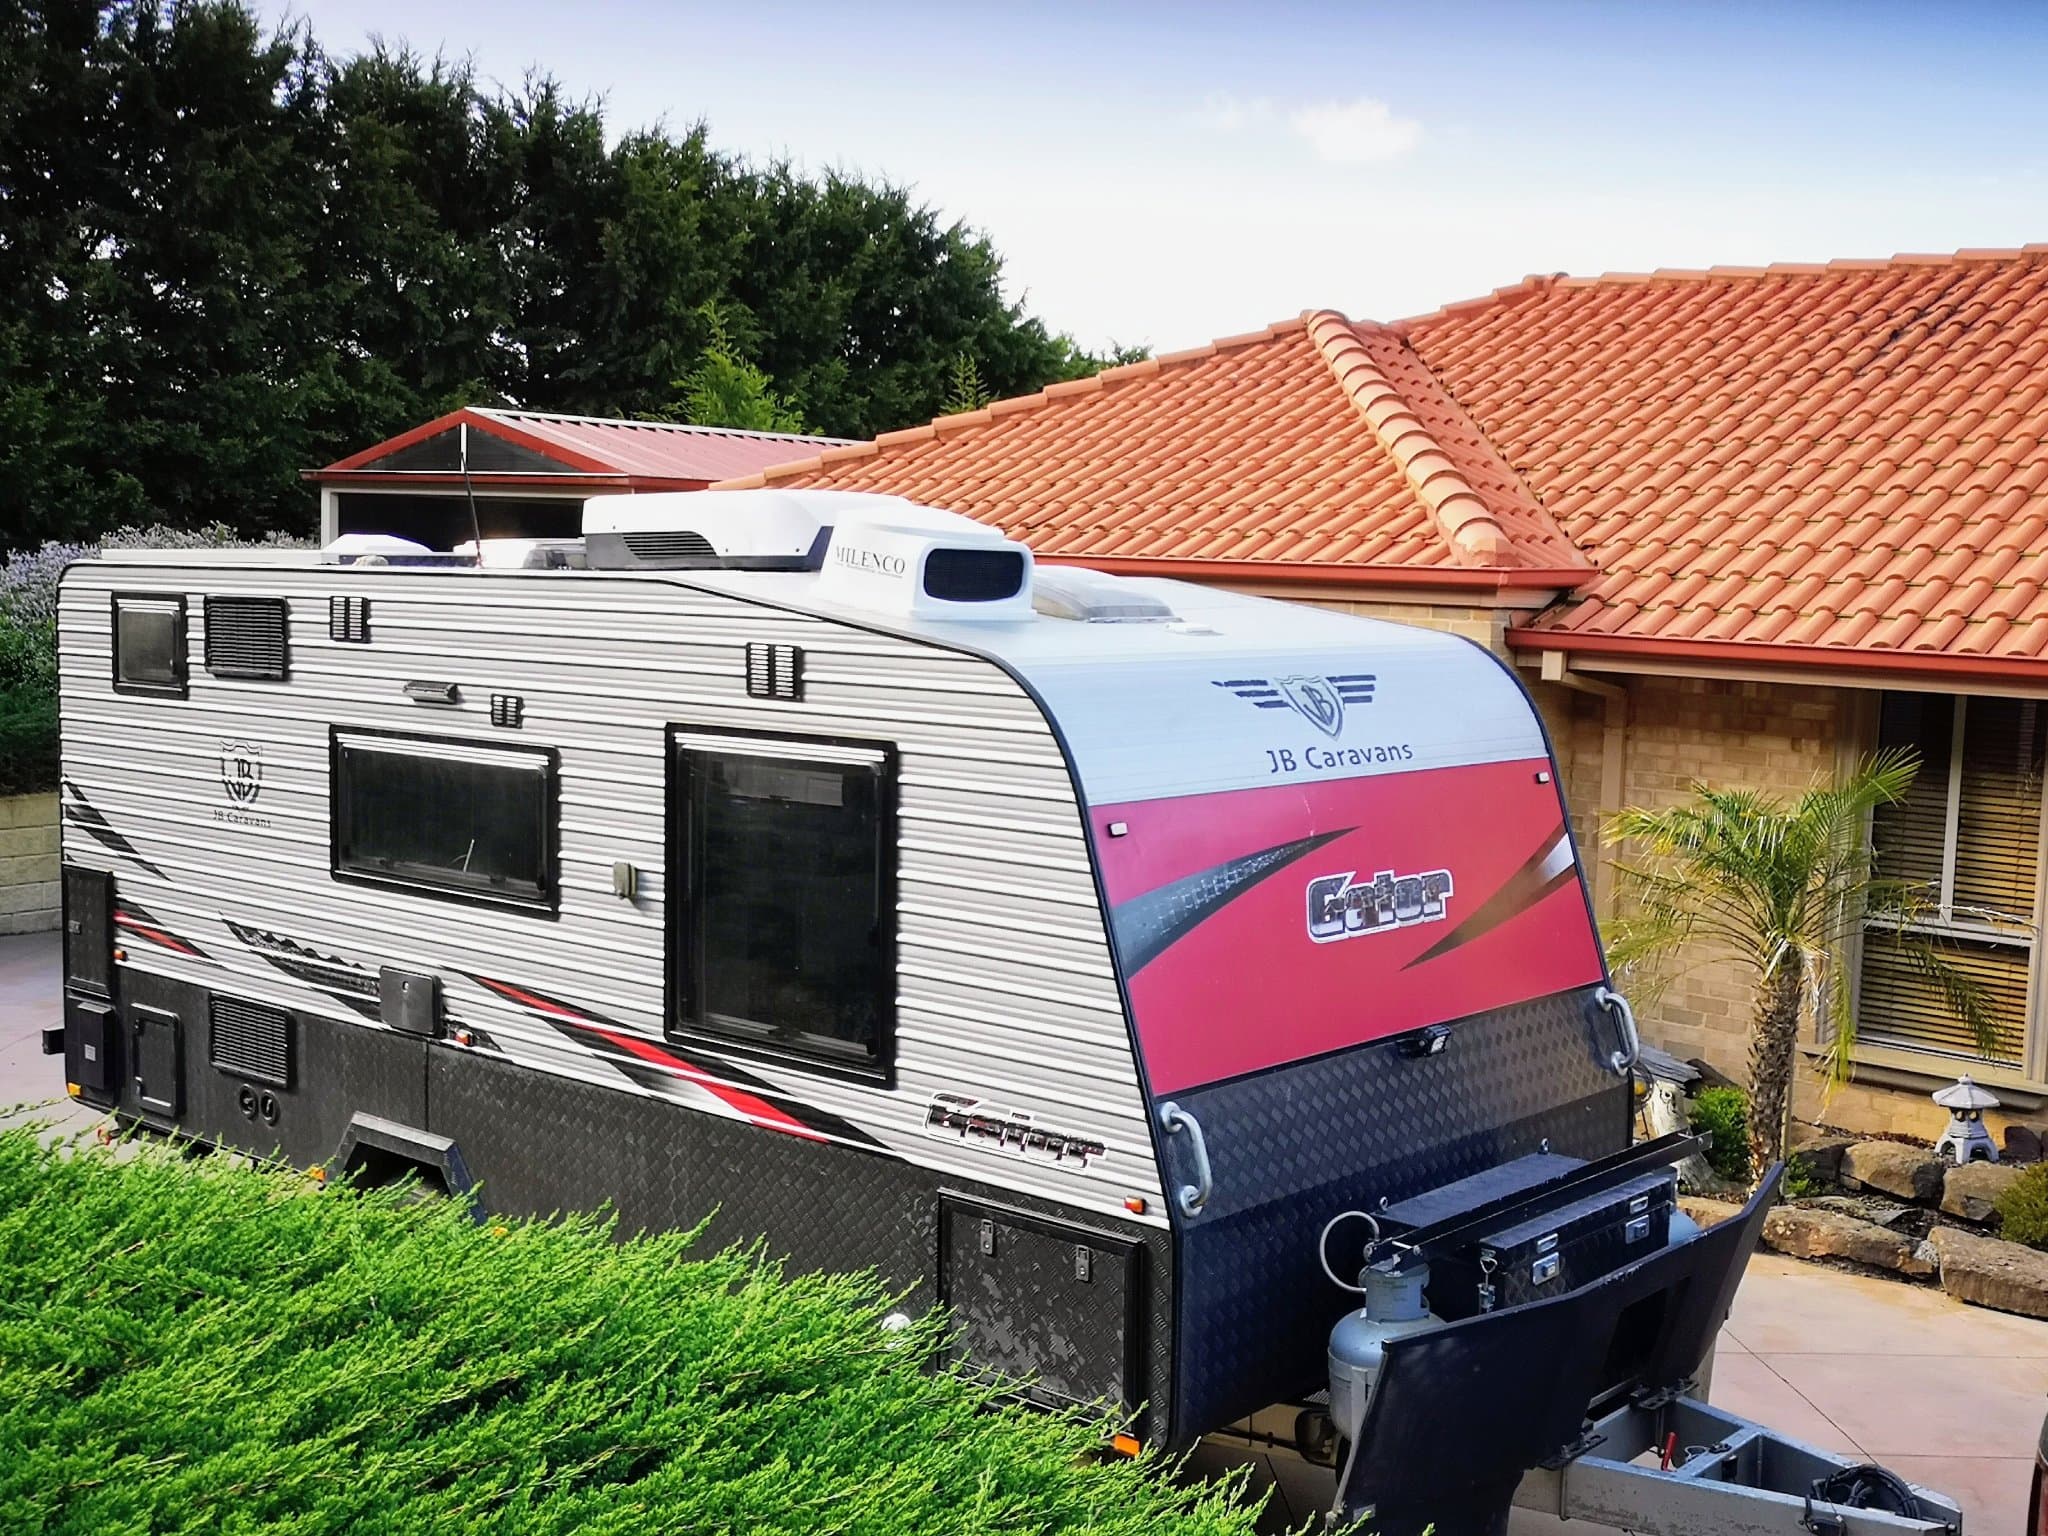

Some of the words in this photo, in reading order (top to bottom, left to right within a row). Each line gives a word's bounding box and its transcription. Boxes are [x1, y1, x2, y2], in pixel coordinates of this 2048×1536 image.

[836, 546, 905, 574] MILENCO
[1266, 749, 1298, 773] JB
[1305, 744, 1414, 770] Caravans
[213, 809, 224, 821] JB
[1305, 869, 1454, 944] Gator
